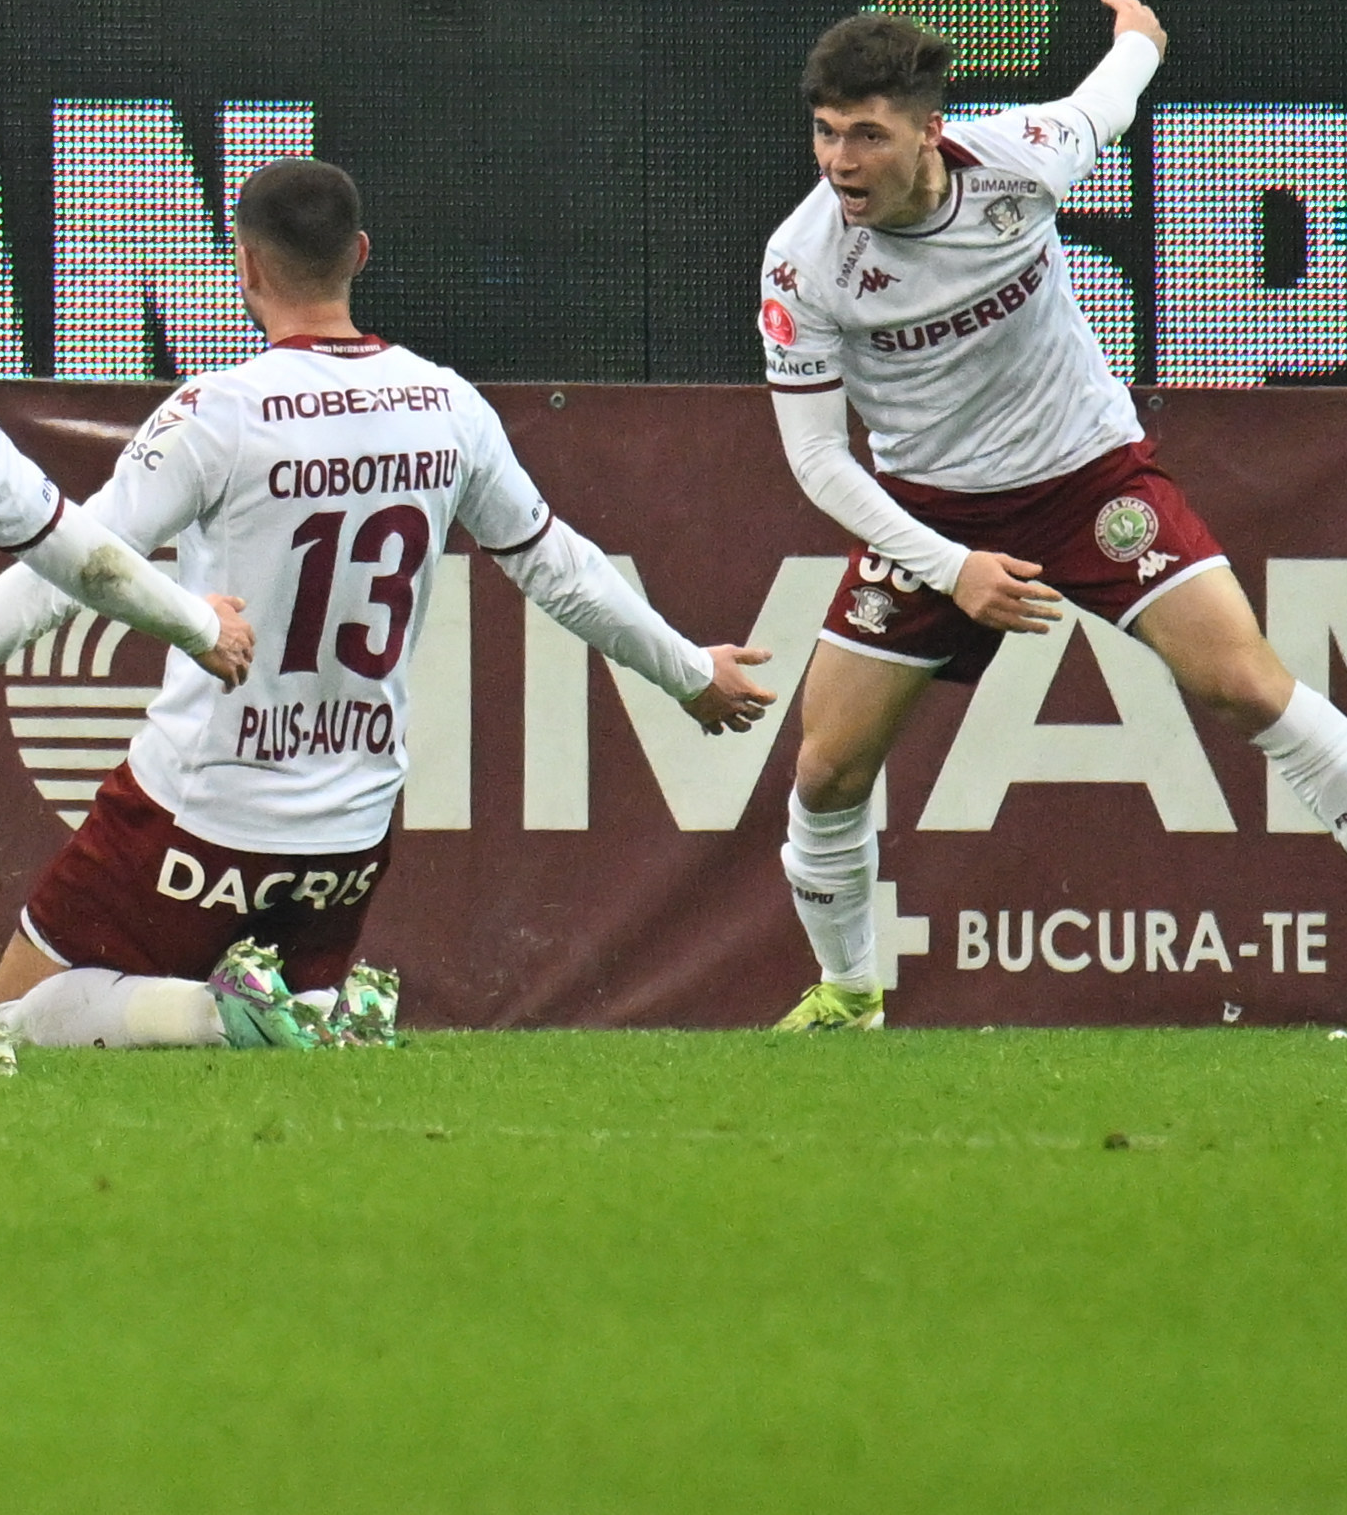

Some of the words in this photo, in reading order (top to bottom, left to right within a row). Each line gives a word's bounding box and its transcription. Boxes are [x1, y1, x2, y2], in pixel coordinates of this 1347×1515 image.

[870, 244, 1050, 352] SUPERBET
[767, 360, 826, 376] NANCE
[262, 385, 453, 422] MOBEXPERT
[268, 448, 458, 500] CIOBOTARIU
[278, 504, 430, 681] 13
[156, 848, 378, 915] DACRIS
[956, 909, 1328, 973] BUCURA-TE
